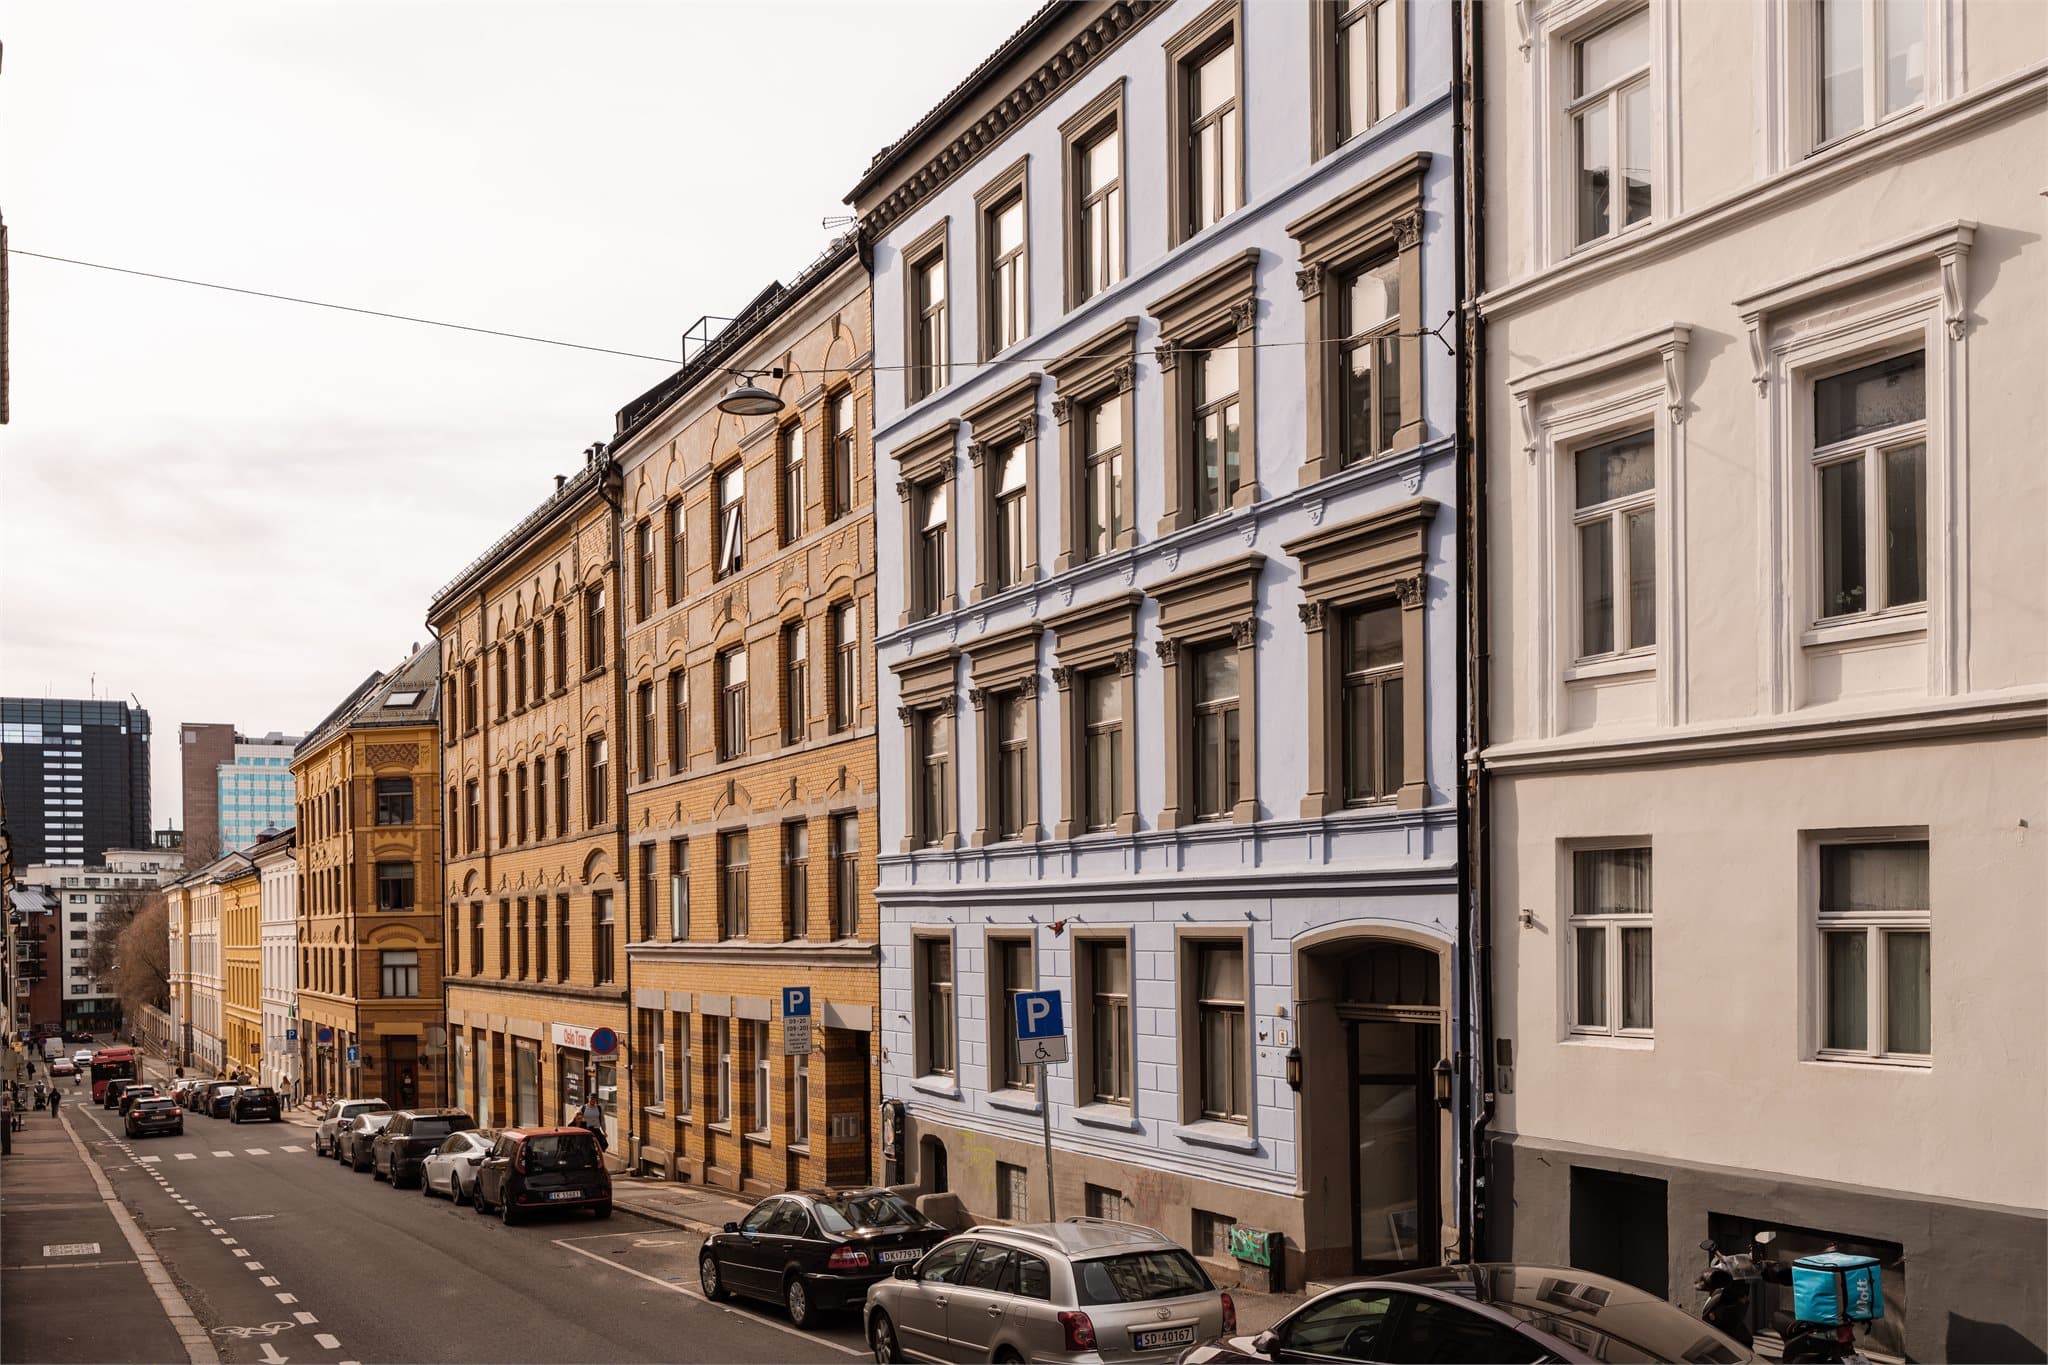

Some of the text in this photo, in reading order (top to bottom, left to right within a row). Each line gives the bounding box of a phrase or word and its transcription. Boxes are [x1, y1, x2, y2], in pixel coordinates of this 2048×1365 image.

[790, 991, 804, 1013] P
[1026, 997, 1050, 1033] P
[288, 1031, 295, 1039] P
[1144, 1329, 1190, 1345] SD 40167
